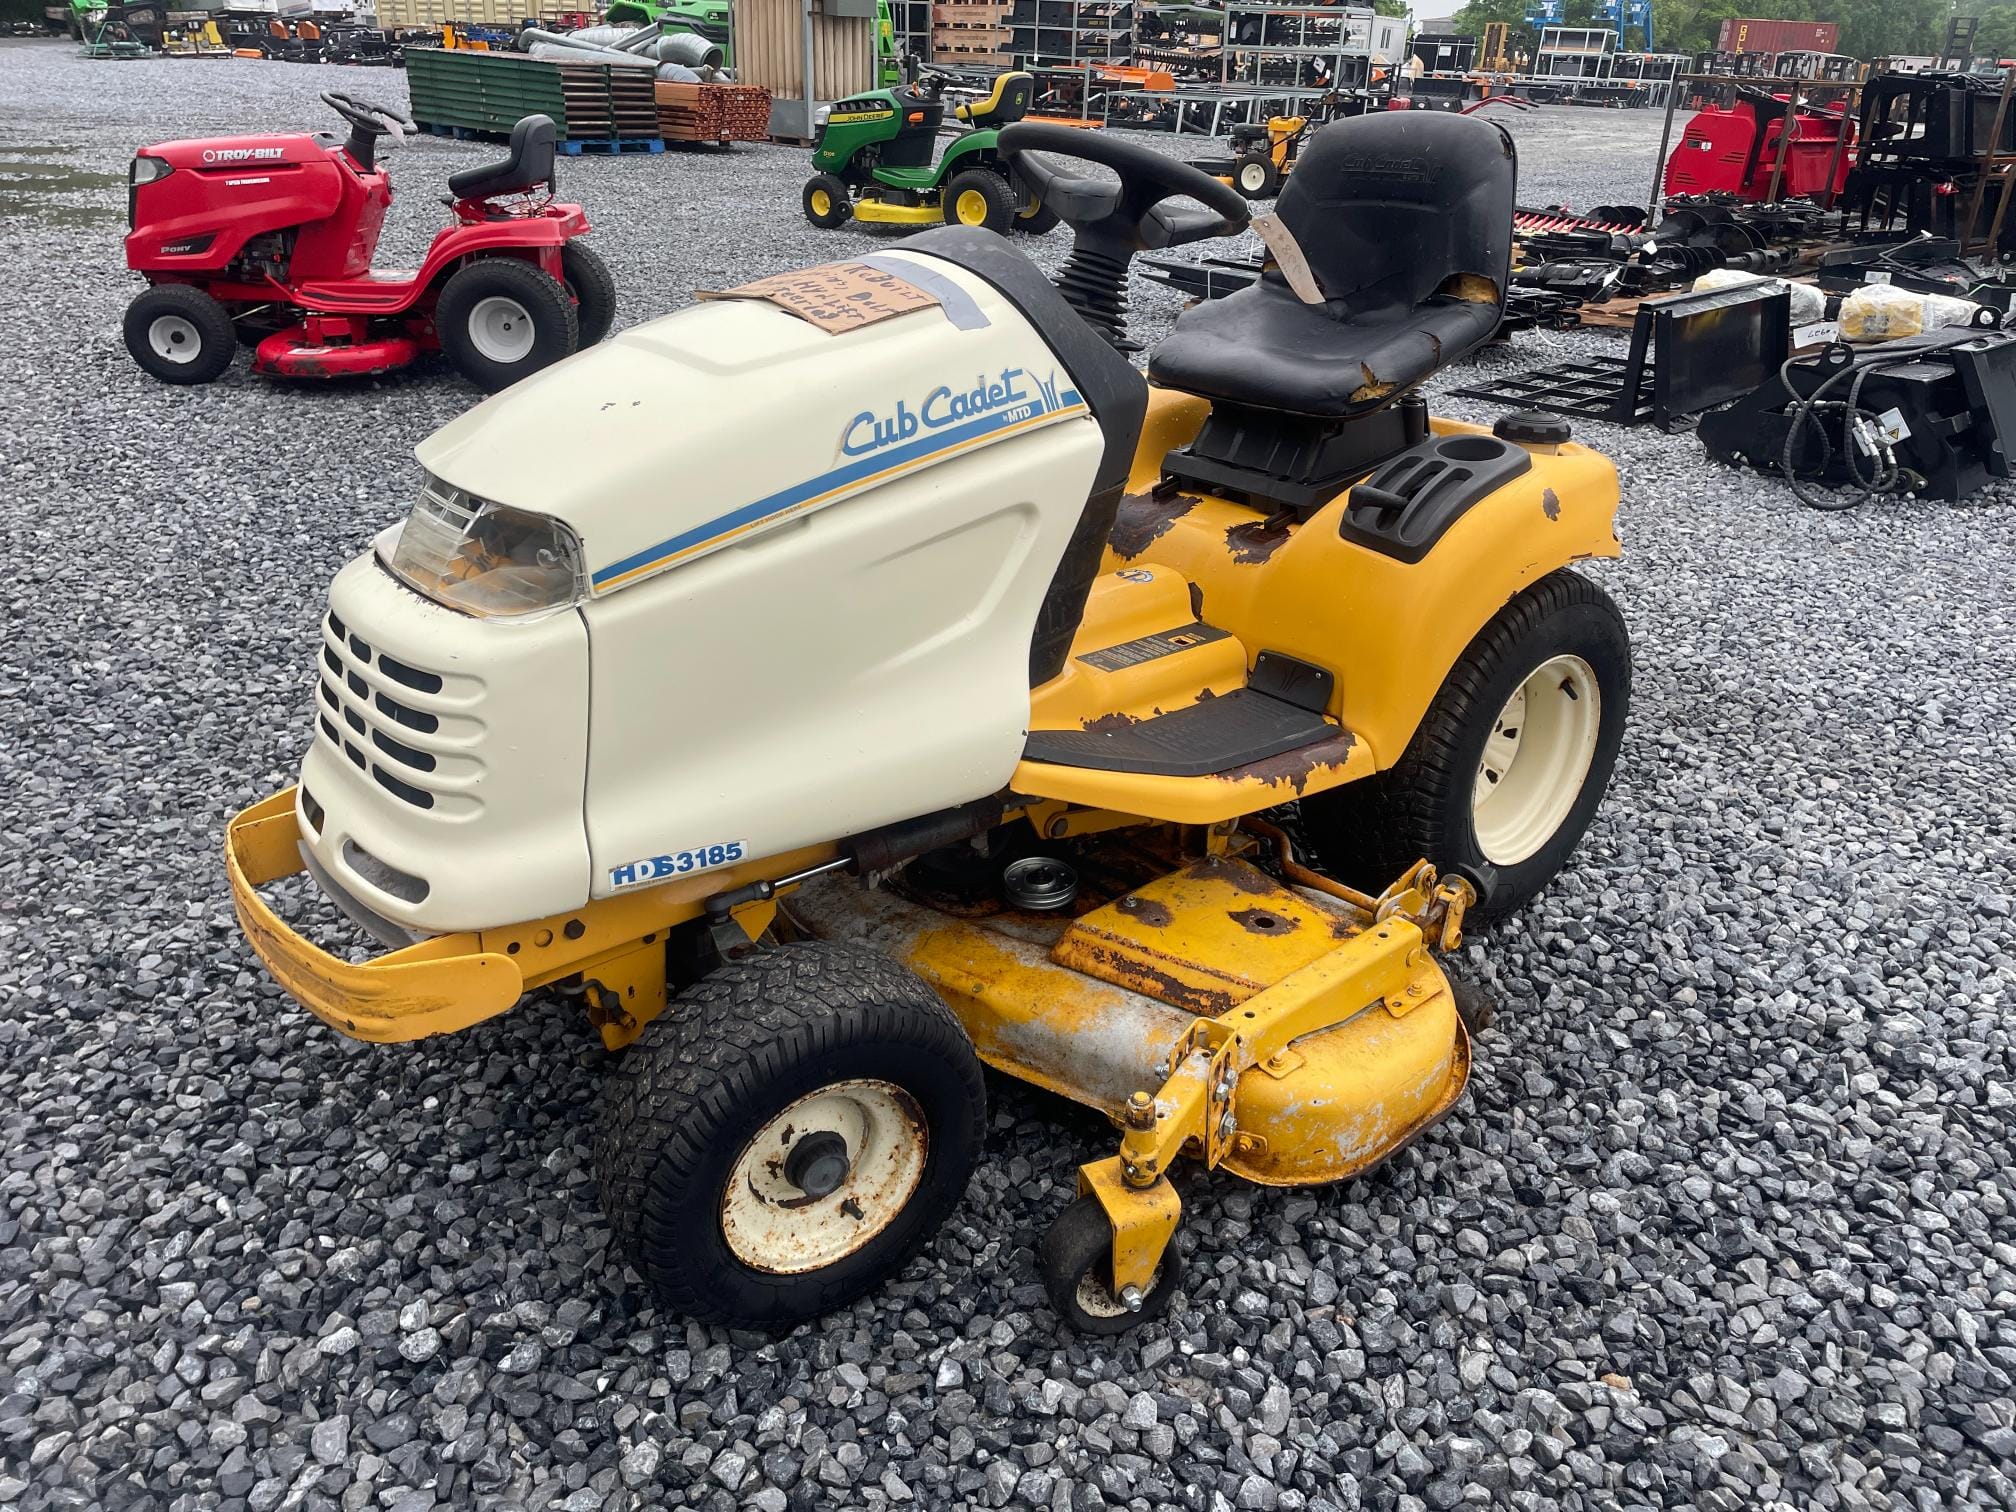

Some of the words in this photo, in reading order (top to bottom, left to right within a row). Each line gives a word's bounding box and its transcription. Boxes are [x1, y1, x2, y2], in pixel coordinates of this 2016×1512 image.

[215, 148, 284, 161] TROY-BILT
[841, 400, 918, 457] Cub
[921, 368, 1027, 429] Cadet
[1007, 405, 1031, 423] MTD
